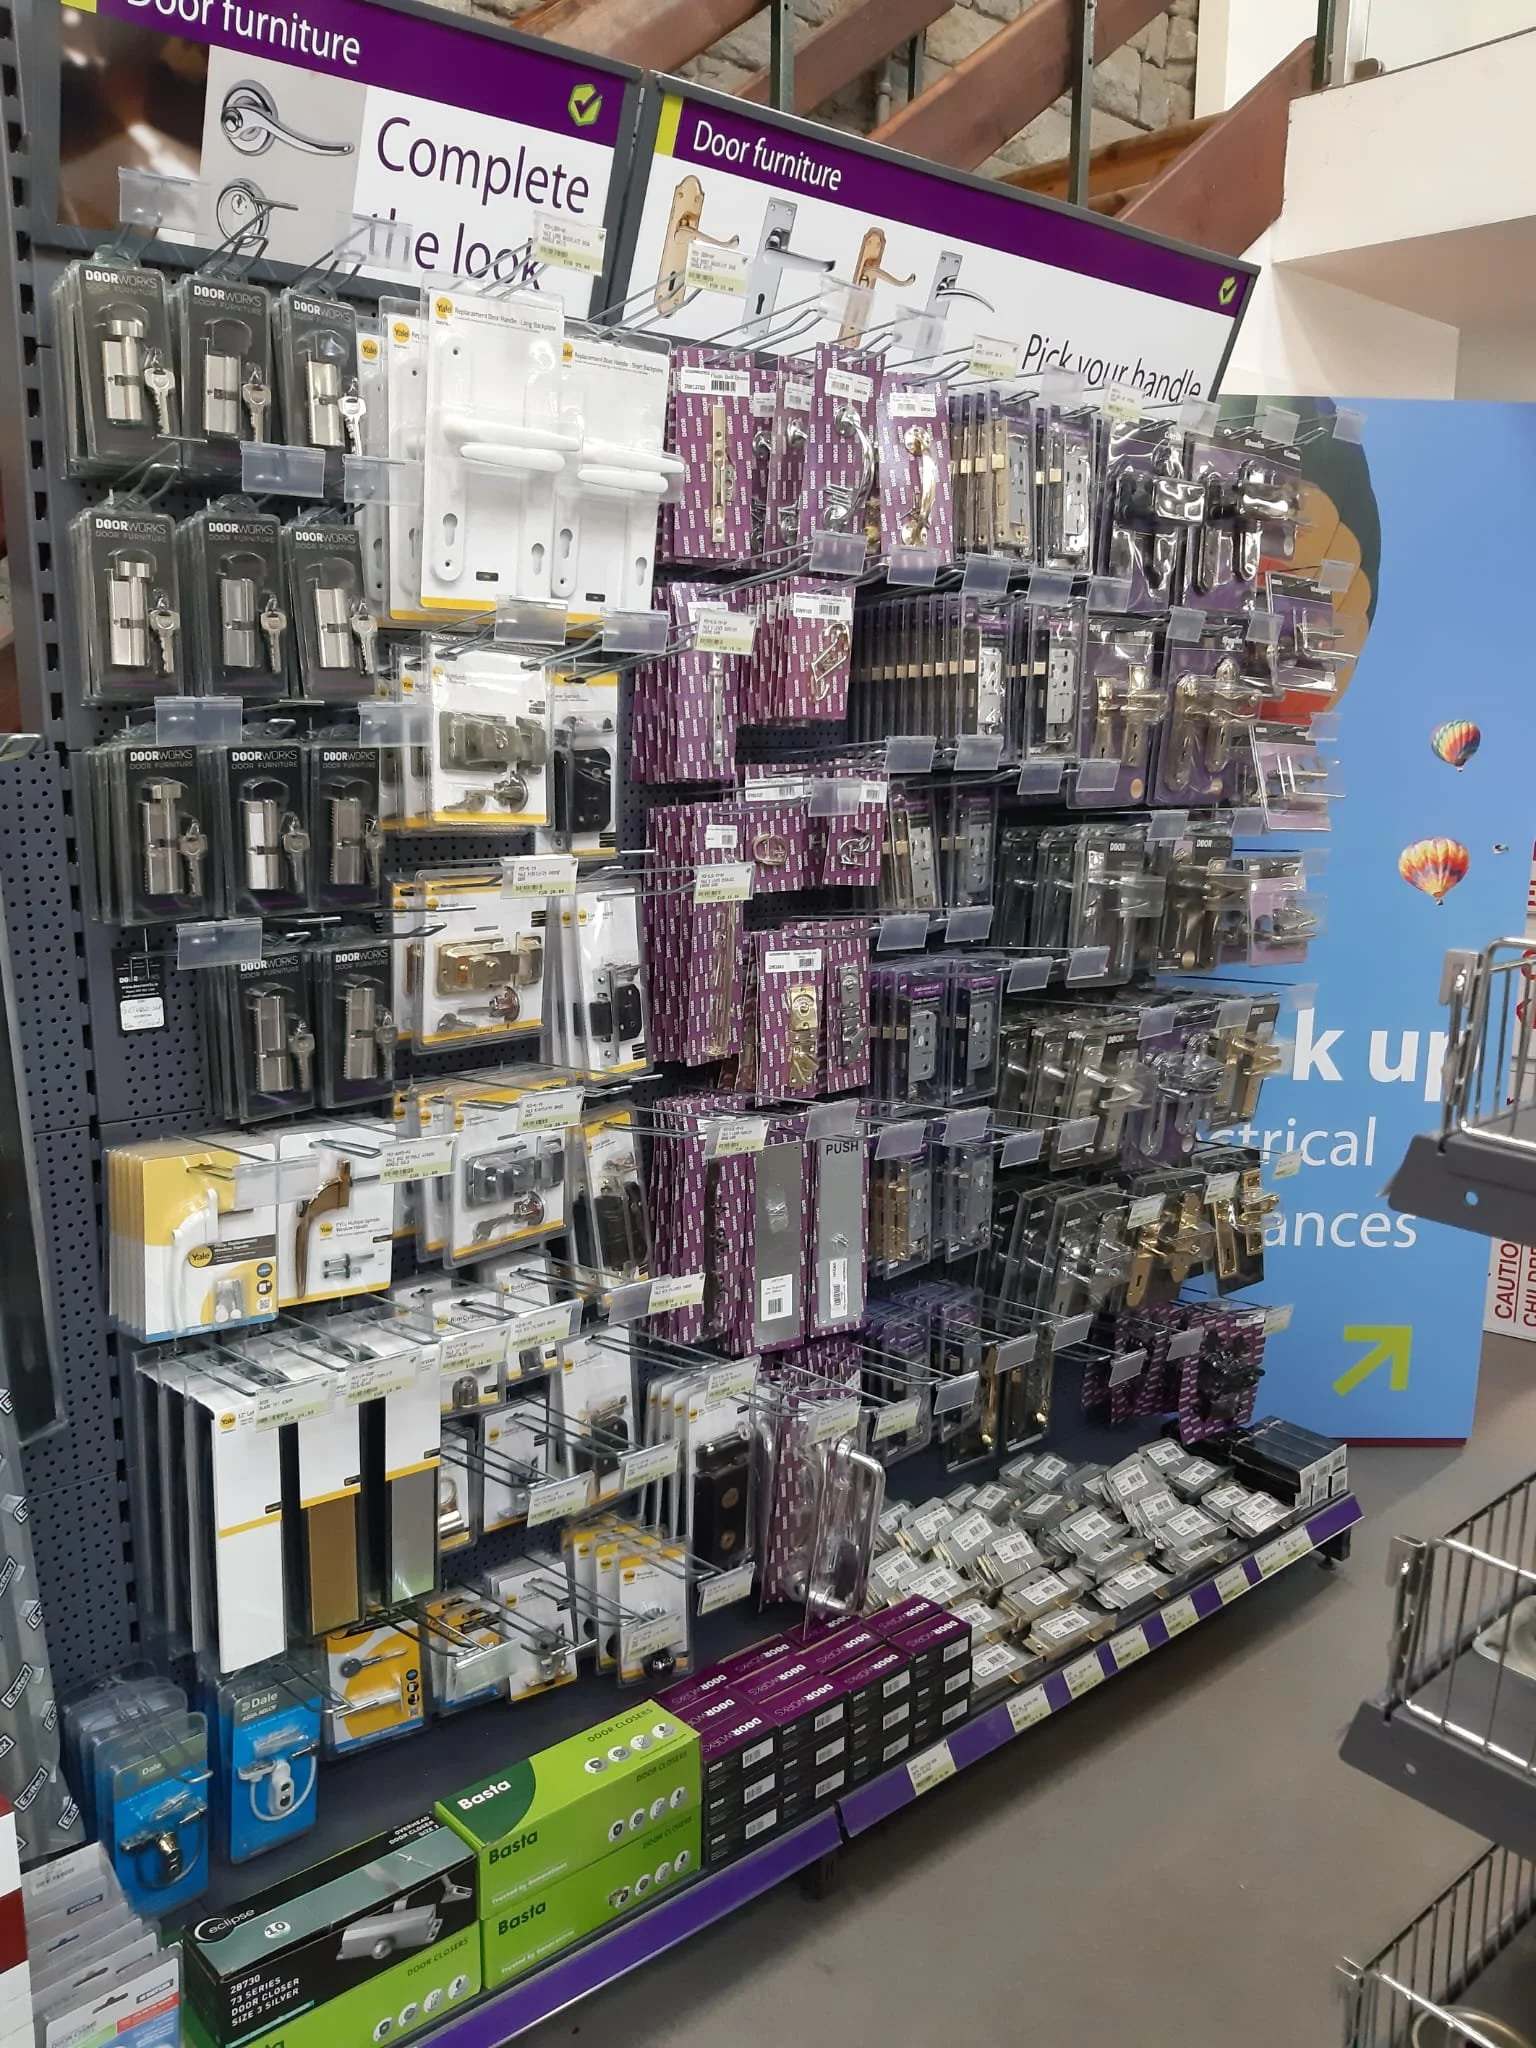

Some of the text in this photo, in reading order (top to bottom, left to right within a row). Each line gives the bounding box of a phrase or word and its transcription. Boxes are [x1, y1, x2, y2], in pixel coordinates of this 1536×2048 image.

[127, 0, 361, 65] oor furniture
[377, 116, 590, 213] Complete
[693, 119, 842, 191] Door furniture
[453, 222, 541, 290] look
[85, 269, 157, 289] DOORWORKS
[194, 284, 262, 308] DOORWORKS
[294, 299, 351, 322] DOORWORKS
[1021, 333, 1073, 372] Pick
[1078, 355, 1129, 387] your
[1130, 357, 1202, 403] handle
[95, 518, 167, 535] DOORWORKS
[209, 522, 274, 536] DOORWORKS
[296, 531, 356, 545] DOORWORKS
[130, 750, 193, 762] DOORWORKS
[130, 761, 193, 770] DOOR FURNITURE
[232, 750, 298, 762] DOORWORKS
[232, 761, 298, 770] DOOR FURNITURE
[323, 751, 376, 762] DOORWORKS
[240, 955, 299, 972] DOORWORKS
[335, 949, 389, 964] DOORWORKS
[1293, 1008, 1344, 1081] k
[826, 1141, 859, 1155] PUSH
[1196, 1116, 1377, 1166] trical
[1263, 1211, 1417, 1248] ances
[191, 1251, 210, 1263] Yale
[1494, 1243, 1519, 1319] CAUTIO
[879, 1602, 930, 1629] DOORWORKS
[906, 1620, 959, 1647] DOORWORKS
[735, 1643, 790, 1672] DOORWORKS
[816, 1633, 871, 1664] DOORWORKS
[749, 1663, 807, 1696] DOORWORKS
[845, 1654, 899, 1685] DOORWORKS
[6, 1670, 30, 1704] Exitex
[251, 1693, 278, 1709] Dale
[672, 1674, 728, 1704] DOORWORKS
[775, 1683, 834, 1717] DOORWORKS
[587, 1707, 654, 1743] DOOR CLOSERS
[702, 1717, 763, 1753] DOORWORKS
[142, 1761, 162, 1776] Dale
[635, 1750, 688, 1783] DOOR CLOSERS
[19, 1773, 46, 1807] Exitex
[457, 1780, 512, 1811] Basta
[389, 1819, 435, 1846] DOOR CLOSER
[394, 1815, 430, 1836] OVERHEAD
[489, 1831, 539, 1865] Basta
[208, 1909, 256, 1934] eclipse
[265, 1922, 287, 1936] 10
[498, 1901, 547, 1937] Basta
[407, 1937, 469, 1977] DOOR CLOSERS
[230, 1974, 261, 1994] 28730
[230, 1977, 282, 2006] 73 SERIES
[231, 1978, 300, 2017] DOOR CLOSER
[231, 1988, 300, 2027] SIZE 3 SILVER
